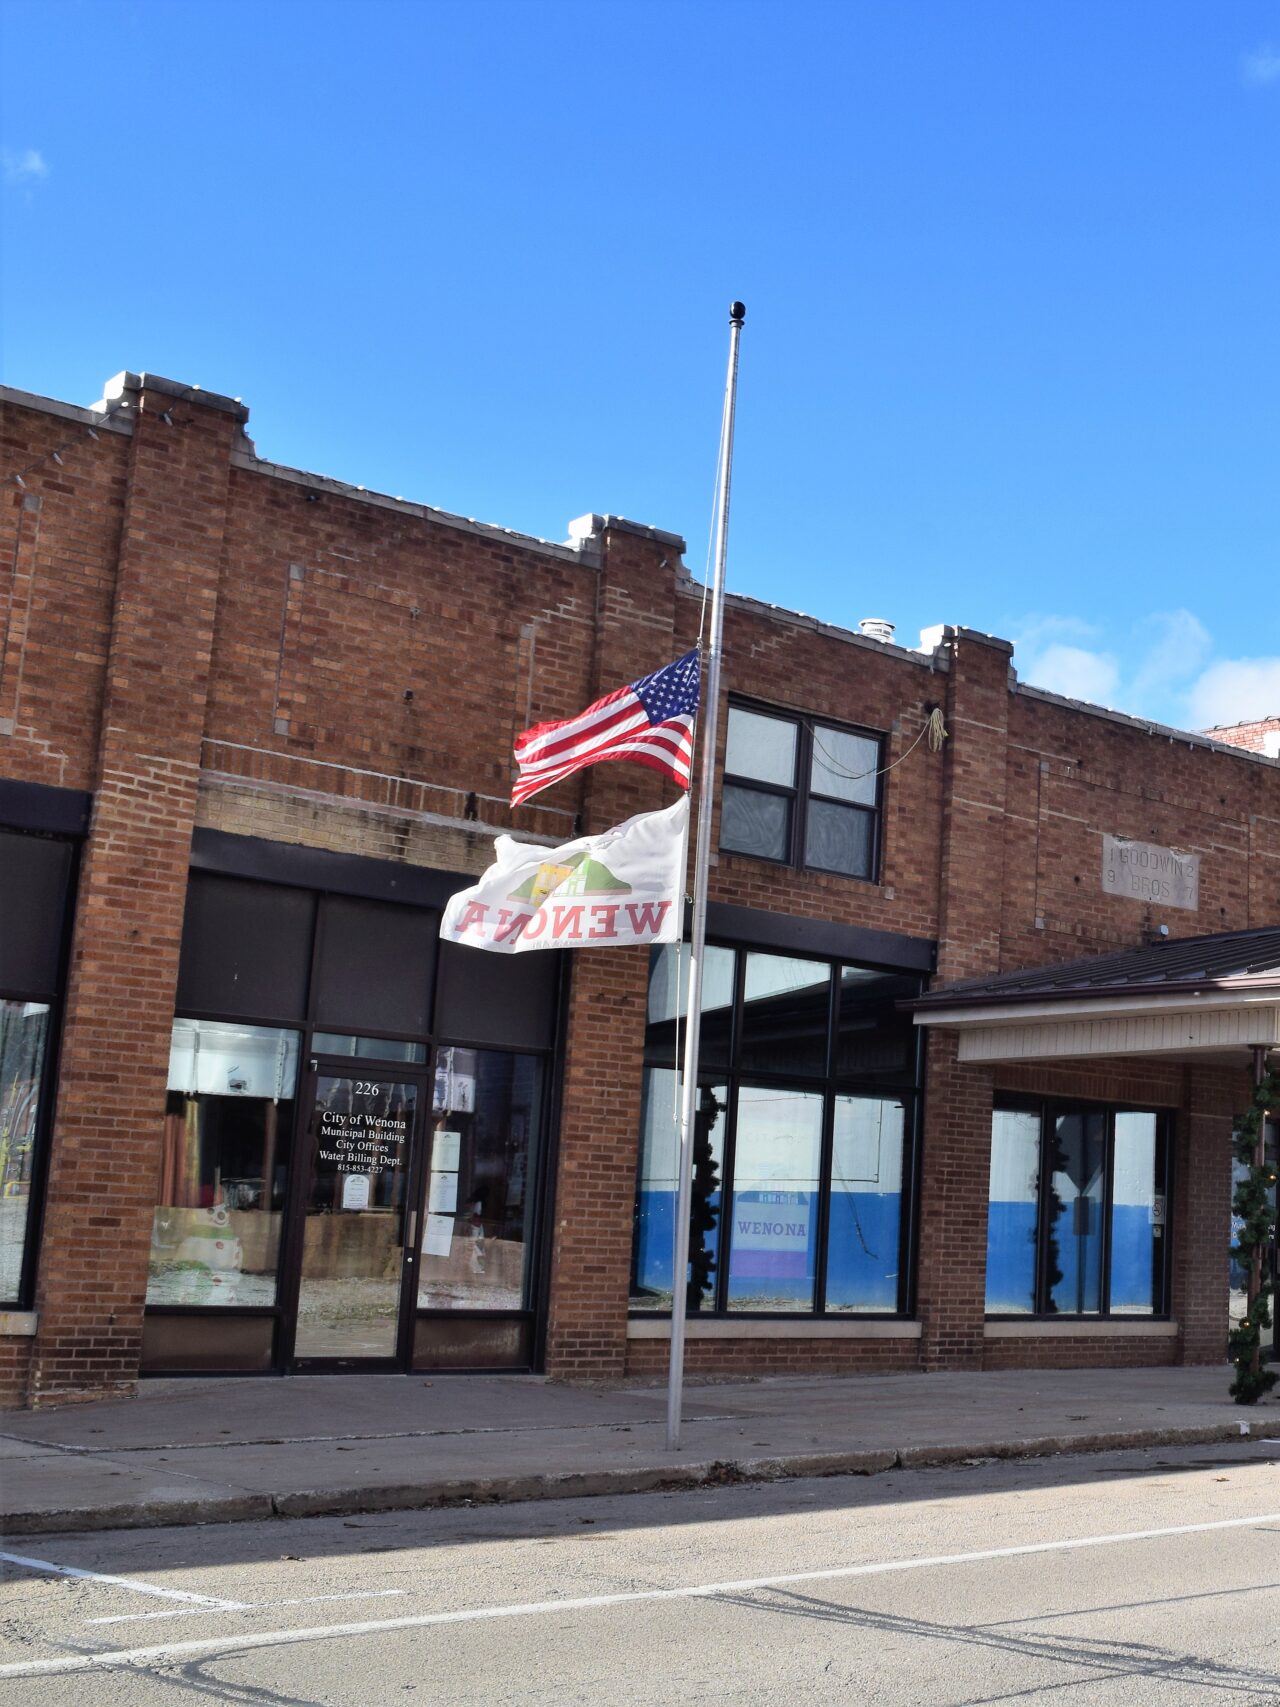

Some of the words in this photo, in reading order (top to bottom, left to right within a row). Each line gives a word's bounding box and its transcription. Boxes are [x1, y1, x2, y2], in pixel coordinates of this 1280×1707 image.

[1119, 847, 1184, 878] GOODWIN
[1131, 875, 1171, 898] BROS
[355, 1082, 379, 1096] 226
[322, 1111, 349, 1126] City
[350, 1114, 363, 1125] of
[365, 1115, 406, 1129] Wenona
[321, 1126, 366, 1139] Municipal
[368, 1130, 405, 1144] Building
[336, 1140, 355, 1152] City
[357, 1141, 389, 1153] Offices
[319, 1151, 345, 1161] Water
[347, 1153, 377, 1166] Billing
[380, 1155, 403, 1167] Dept.
[337, 1163, 384, 1174] 815-853-4227
[738, 1221, 807, 1237] WENONA
